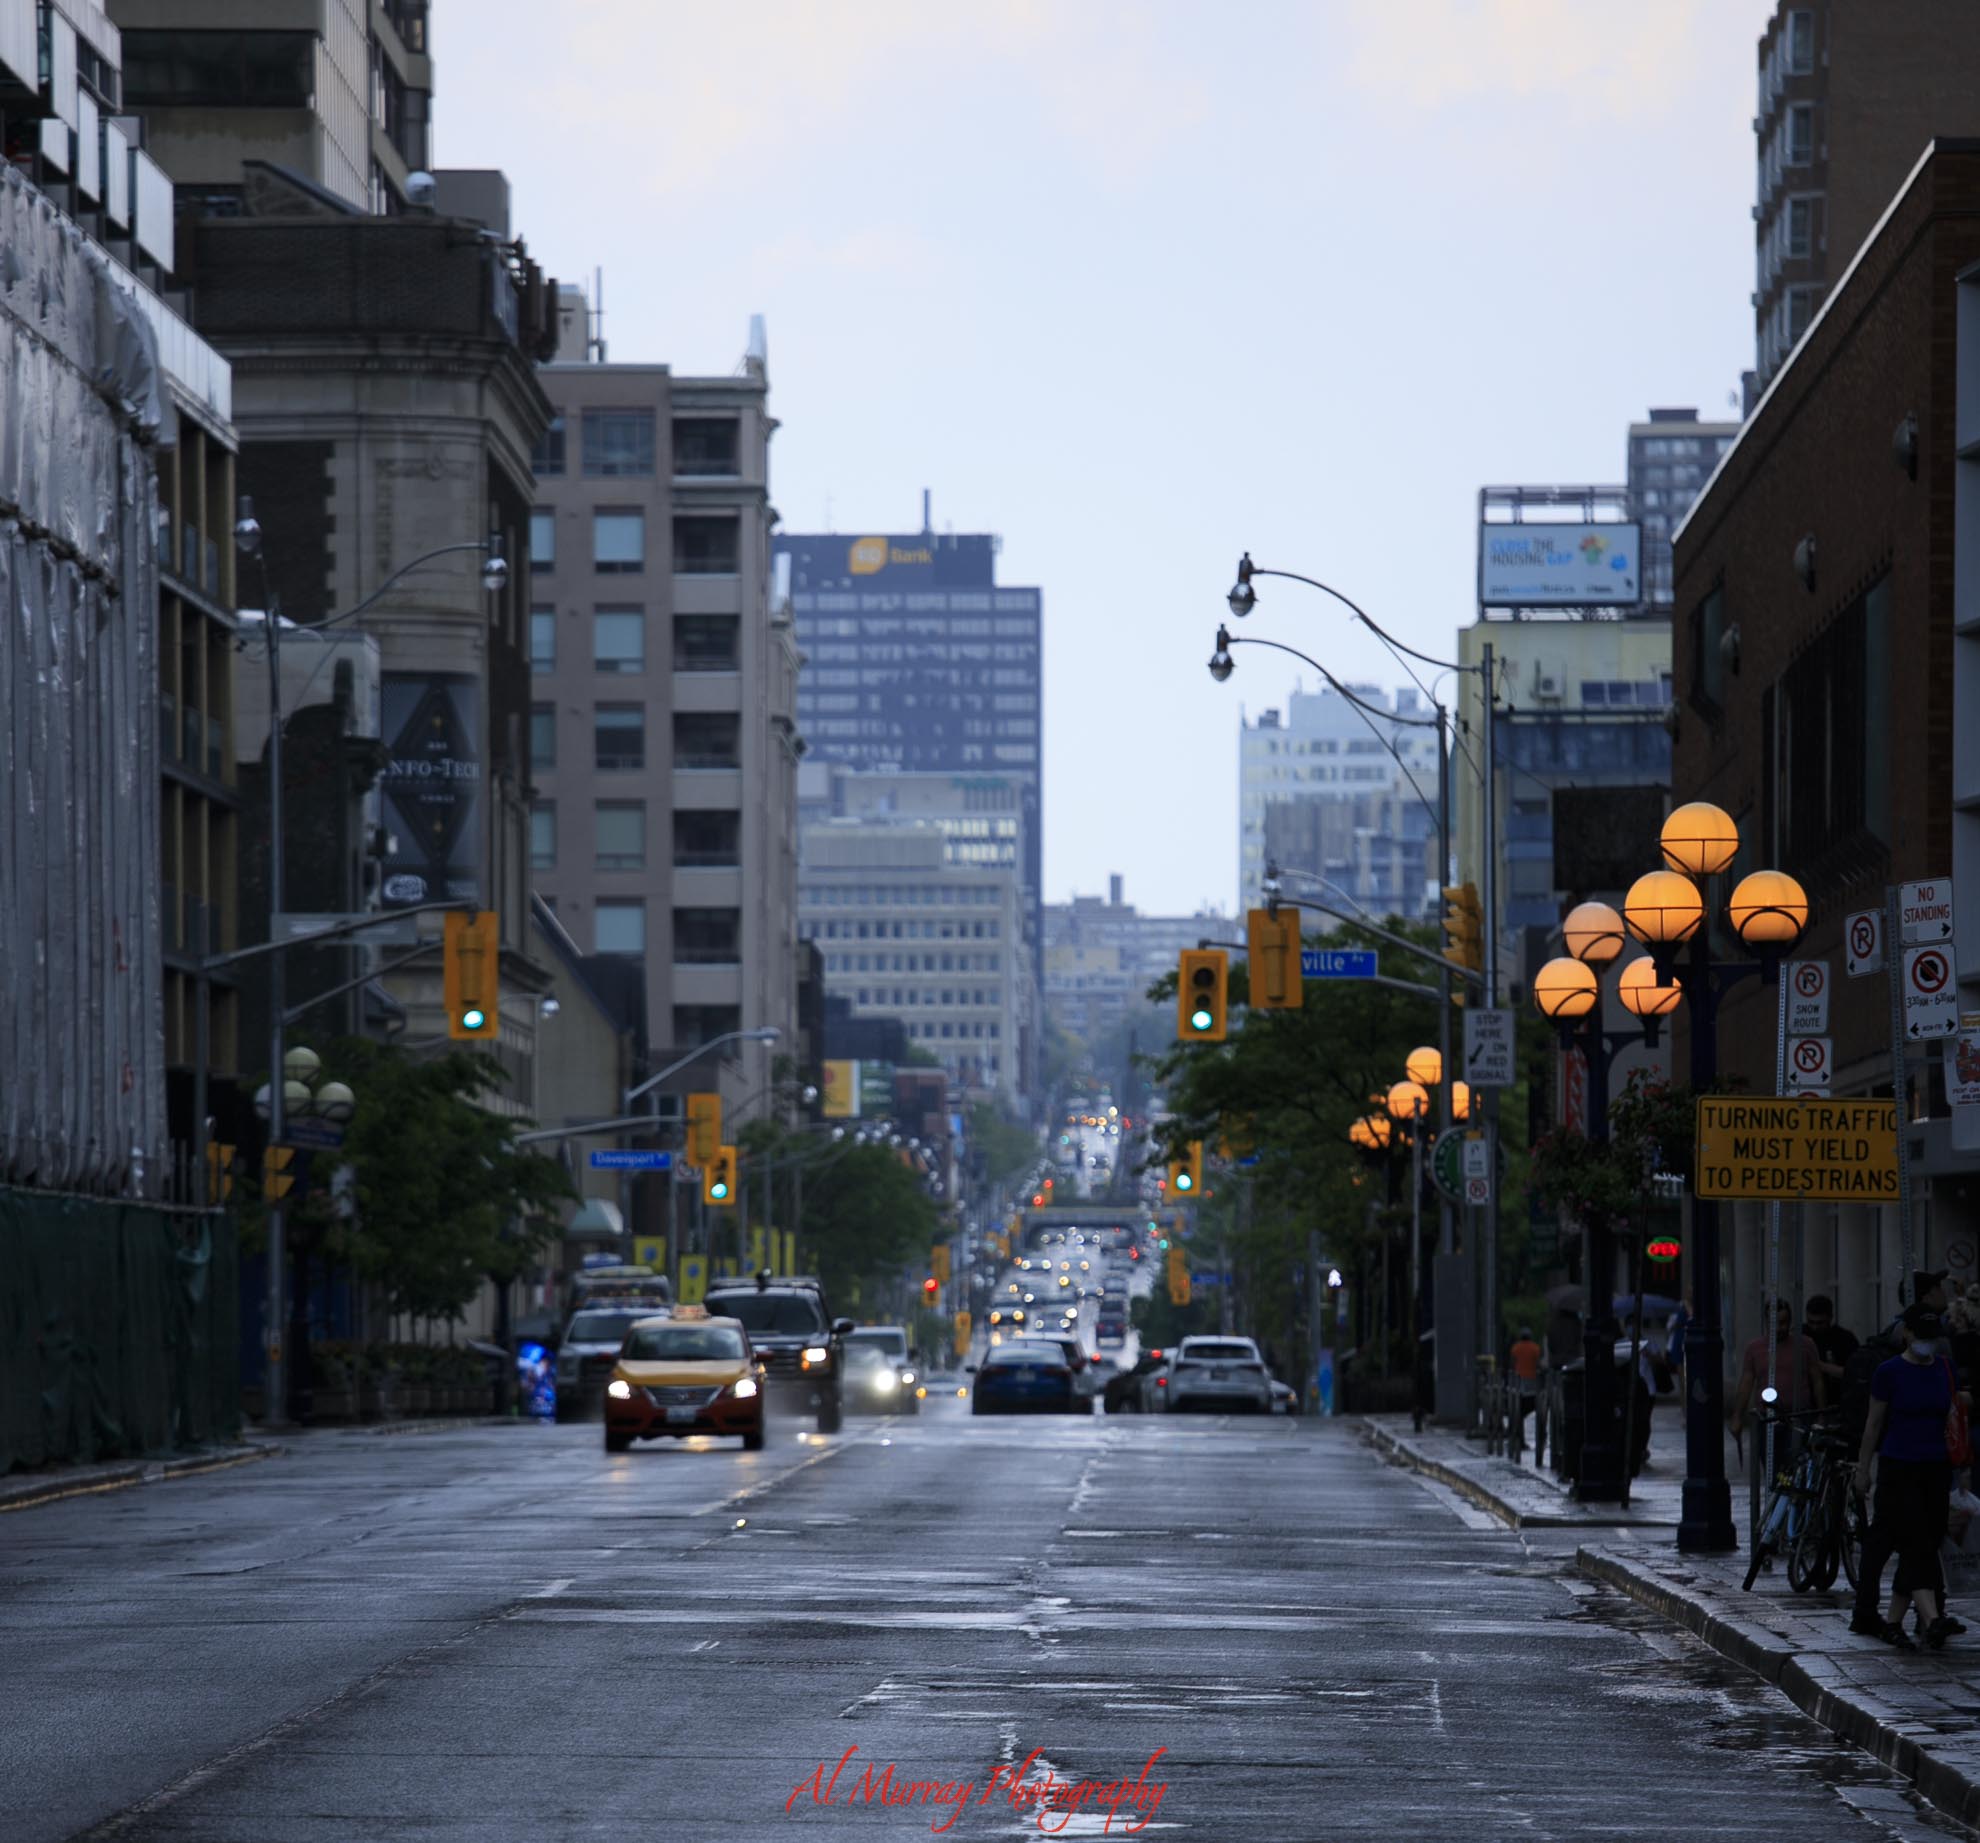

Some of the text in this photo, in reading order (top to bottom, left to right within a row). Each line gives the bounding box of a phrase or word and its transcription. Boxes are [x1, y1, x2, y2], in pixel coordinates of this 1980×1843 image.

[1490, 553, 1545, 567] HOUSING
[389, 757, 481, 779] NFO-TECH
[1917, 886, 1934, 902] NO
[1903, 904, 1950, 923] STANDING
[1796, 1005, 1820, 1015] SNOW
[1475, 1014, 1503, 1025] STOP
[1793, 1018, 1821, 1028] ROUTE
[1475, 1028, 1503, 1039] HERE
[1493, 1042, 1508, 1052] ON
[1486, 1056, 1507, 1066] RED
[1470, 1070, 1507, 1080] SIGNAL
[1704, 1106, 1898, 1131] TURNING TRAFFIC
[1733, 1138, 1870, 1161] MUST YIELD
[595, 1151, 655, 1165] Davenport
[1706, 1167, 1898, 1192] TO PEDESTRIANS
[1648, 1242, 1680, 1256] OPEN
